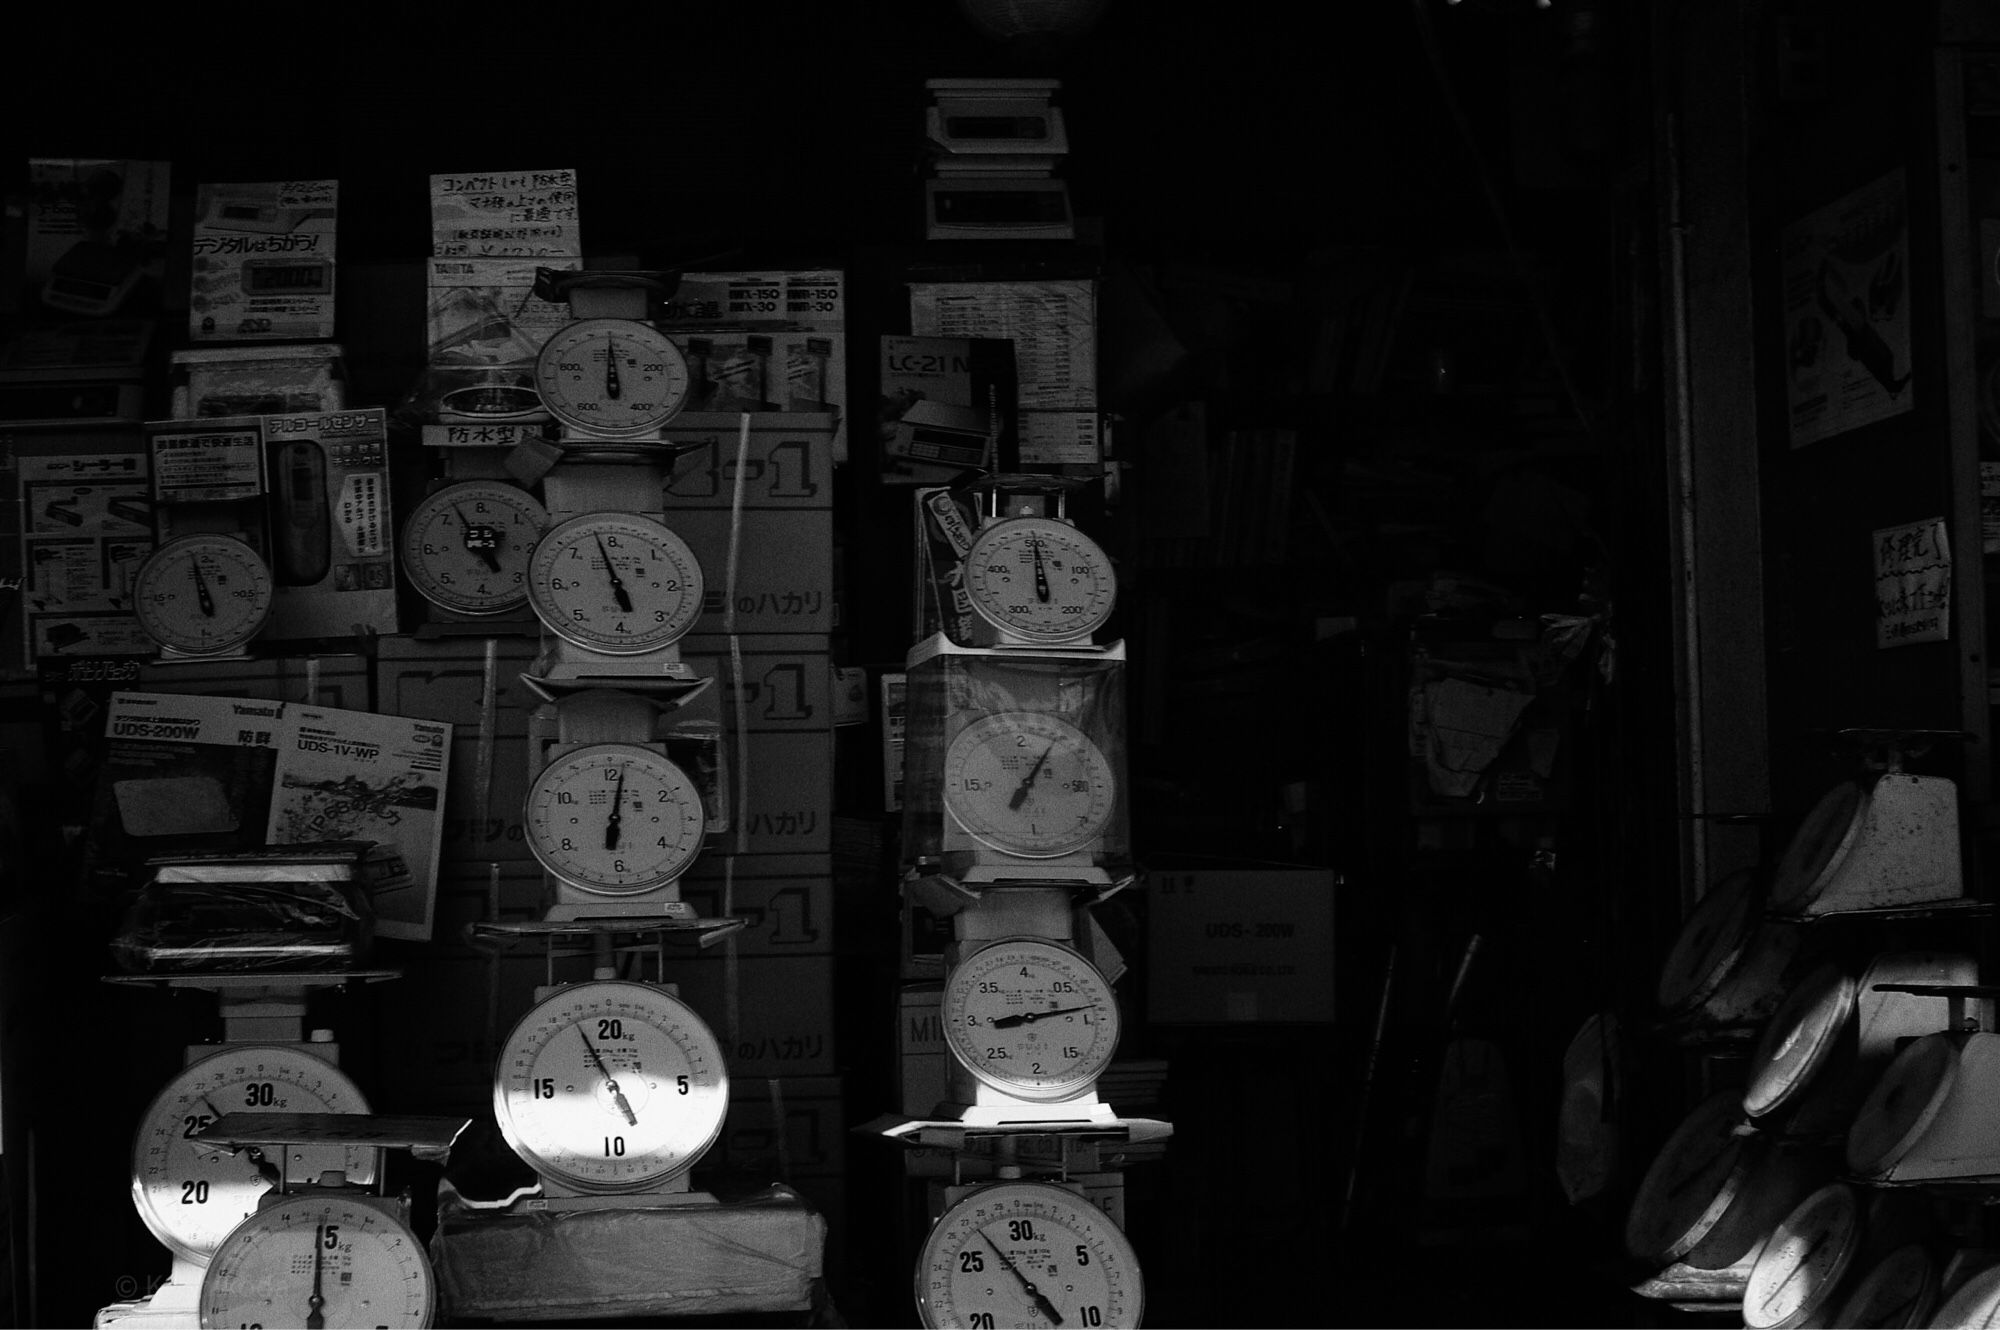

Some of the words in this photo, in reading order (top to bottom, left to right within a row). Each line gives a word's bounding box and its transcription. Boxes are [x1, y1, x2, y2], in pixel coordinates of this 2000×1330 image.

[889, 355, 945, 372] LC-21
[271, 414, 378, 433] アルコールセンサー
[448, 427, 515, 444] 防水型
[703, 591, 822, 615] のハカリ
[233, 704, 274, 717] Yamato
[113, 723, 200, 739] UDS-200W
[297, 739, 380, 759] UDS-1V-WP
[604, 768, 618, 781] 12
[534, 1078, 554, 1099] 15
[677, 1075, 688, 1095] 5
[183, 1115, 212, 1139] 25
[605, 1136, 625, 1157] 10
[182, 1180, 208, 1204] 20
[960, 1251, 984, 1273] 25
[1076, 1245, 1089, 1266] 5
[970, 1313, 994, 1330] 20
[1081, 1306, 1101, 1328] 10
